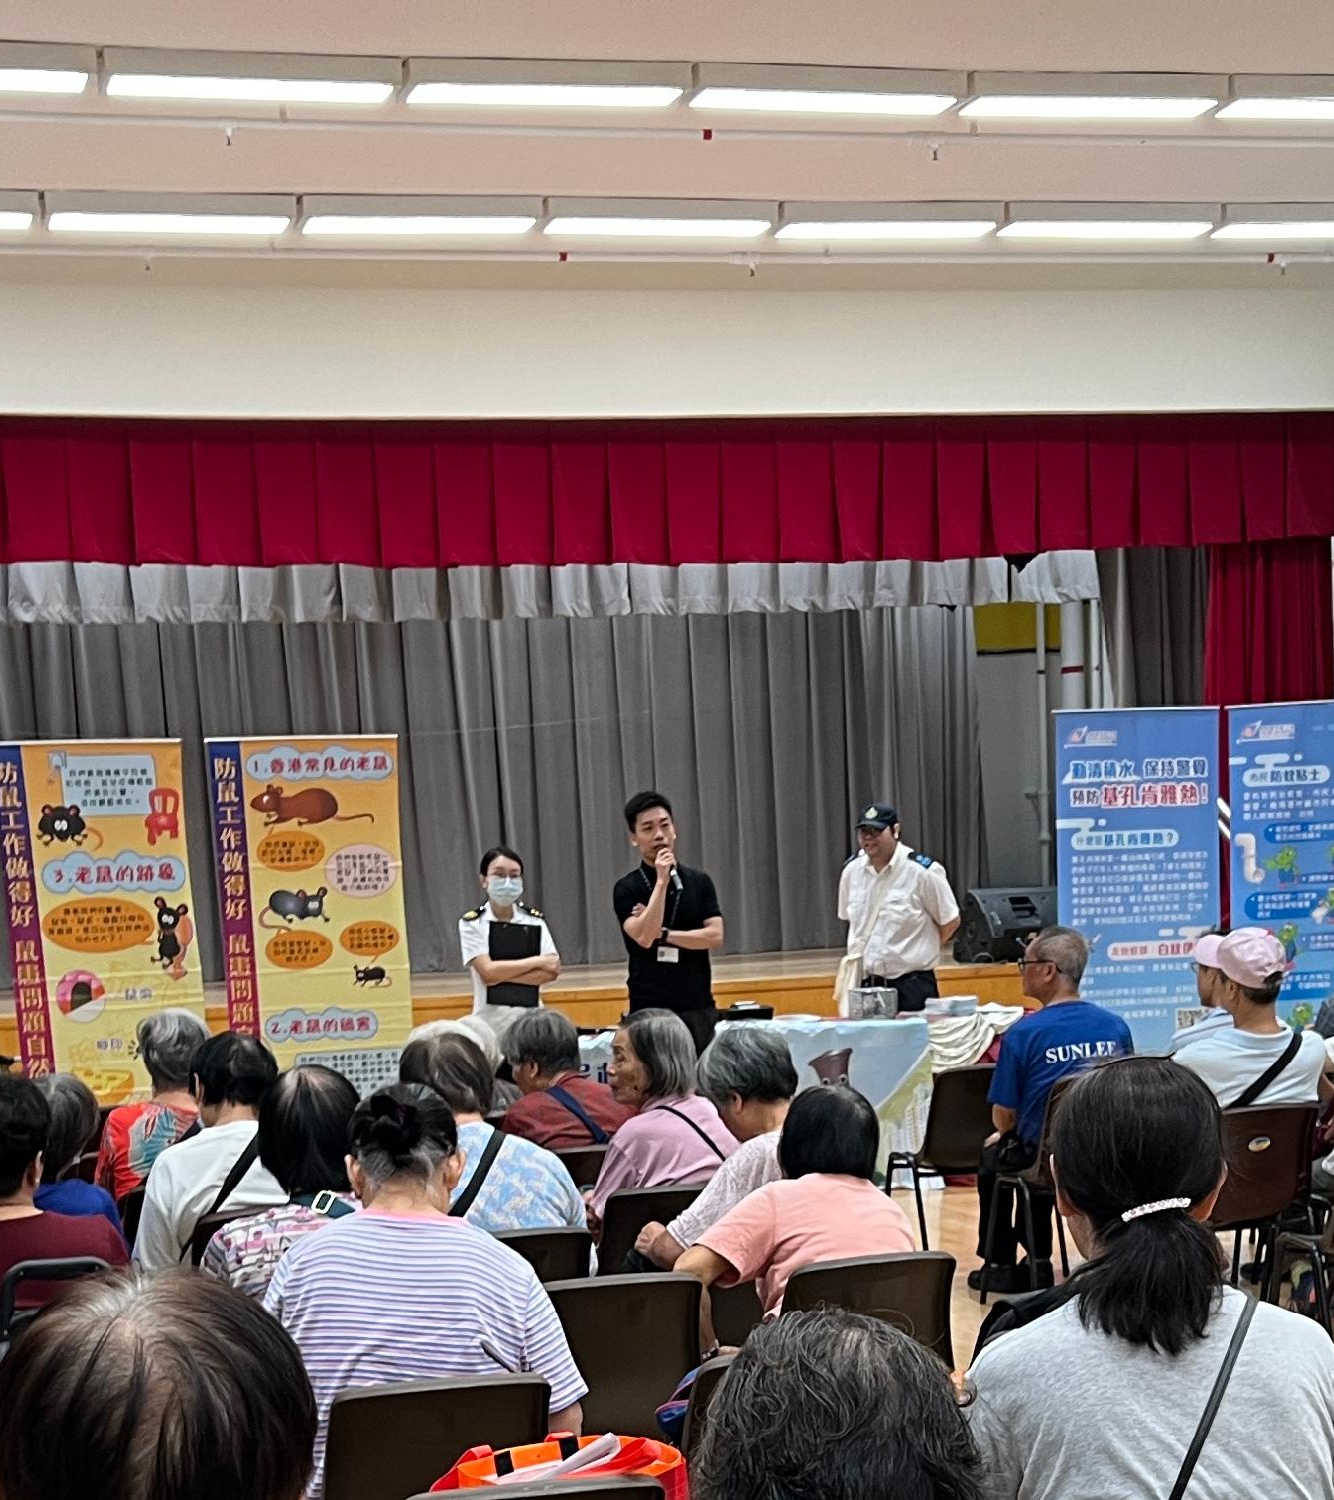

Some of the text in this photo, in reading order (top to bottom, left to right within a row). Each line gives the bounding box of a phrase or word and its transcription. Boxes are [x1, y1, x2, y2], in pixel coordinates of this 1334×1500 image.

[253, 754, 389, 775] 1.香港常見的老鼠
[1145, 758, 1208, 778] 保持警覺
[213, 757, 248, 921] 防鼠工作做得好
